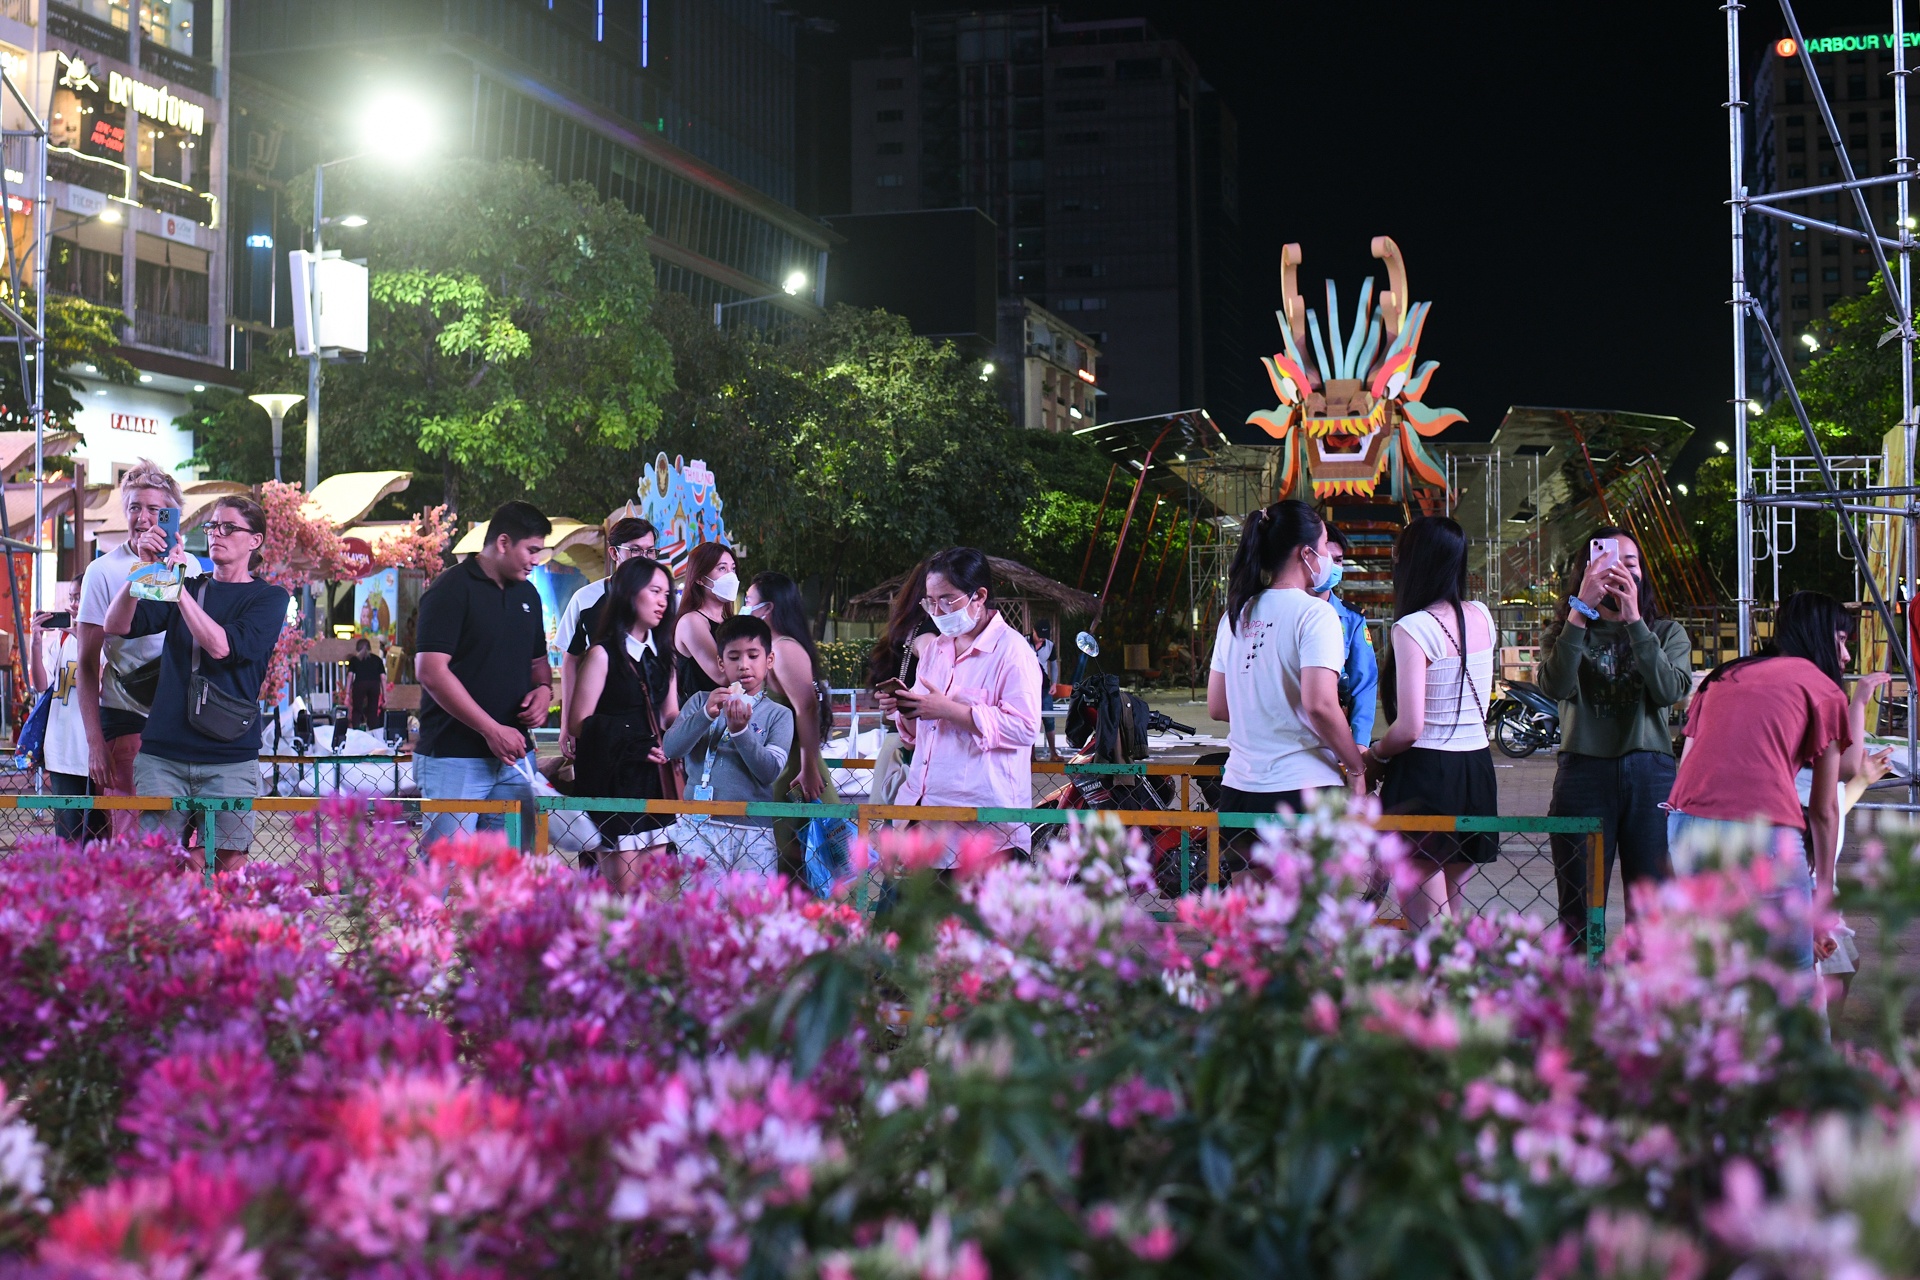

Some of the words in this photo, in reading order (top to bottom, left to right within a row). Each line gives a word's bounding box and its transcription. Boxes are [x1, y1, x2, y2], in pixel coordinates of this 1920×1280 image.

[1882, 32, 1920, 49] VEW
[340, 551, 371, 565] LAYSIA
[1081, 781, 1102, 793] YAMAHA
